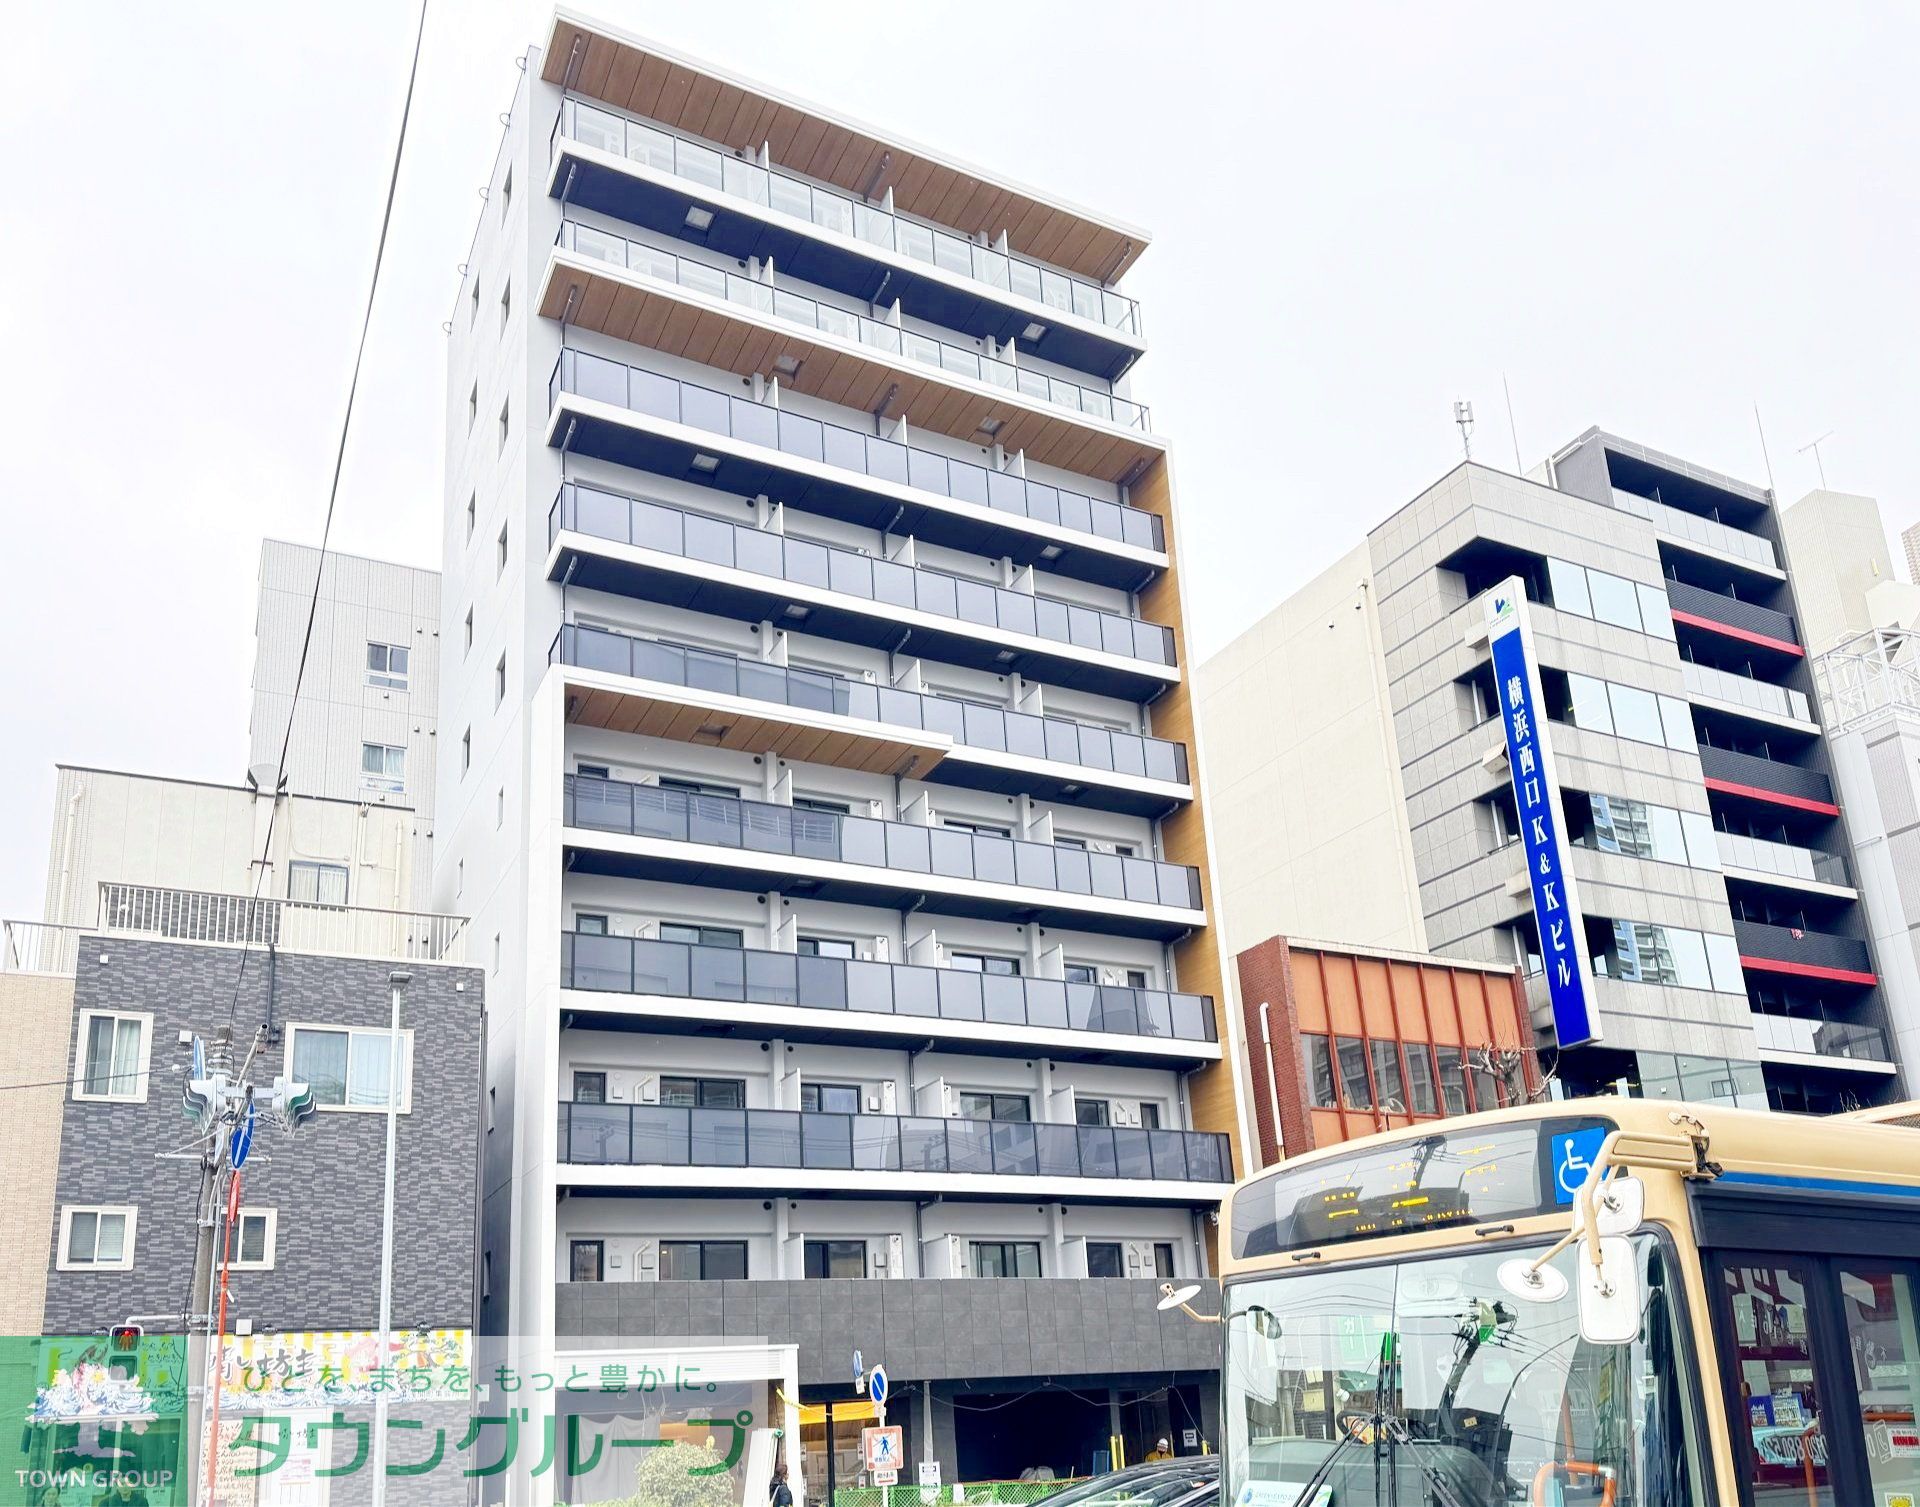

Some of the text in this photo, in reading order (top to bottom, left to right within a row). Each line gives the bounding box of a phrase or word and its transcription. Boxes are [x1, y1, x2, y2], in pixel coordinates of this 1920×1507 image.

[1507, 675, 1571, 988] 横浜西口K&Kビル
